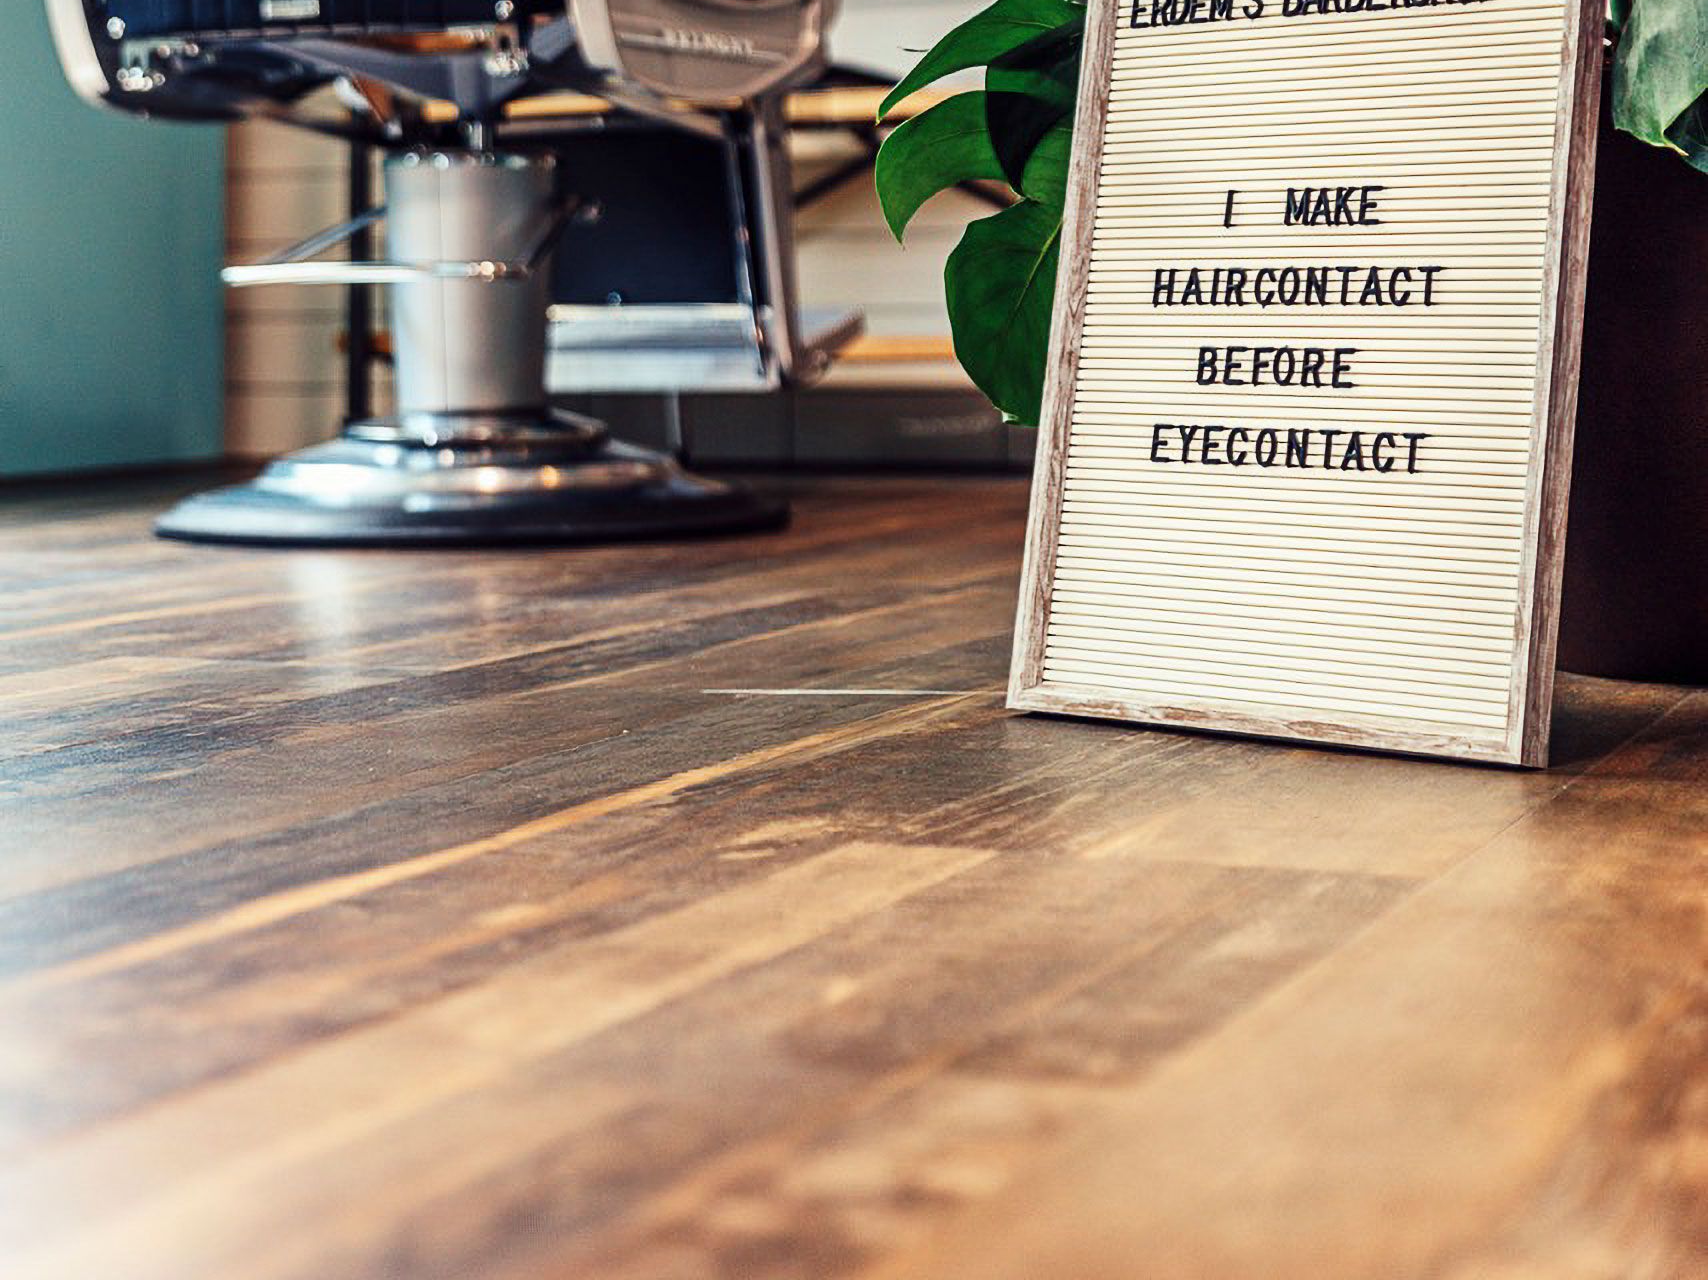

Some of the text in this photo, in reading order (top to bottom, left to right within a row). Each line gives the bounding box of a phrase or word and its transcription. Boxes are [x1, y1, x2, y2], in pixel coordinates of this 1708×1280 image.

[1223, 185, 1385, 228] I MAKE
[1152, 266, 1445, 308] HAIRCONTACT
[1196, 346, 1356, 388] BEFORE
[1150, 423, 1428, 474] EYECONTACT
